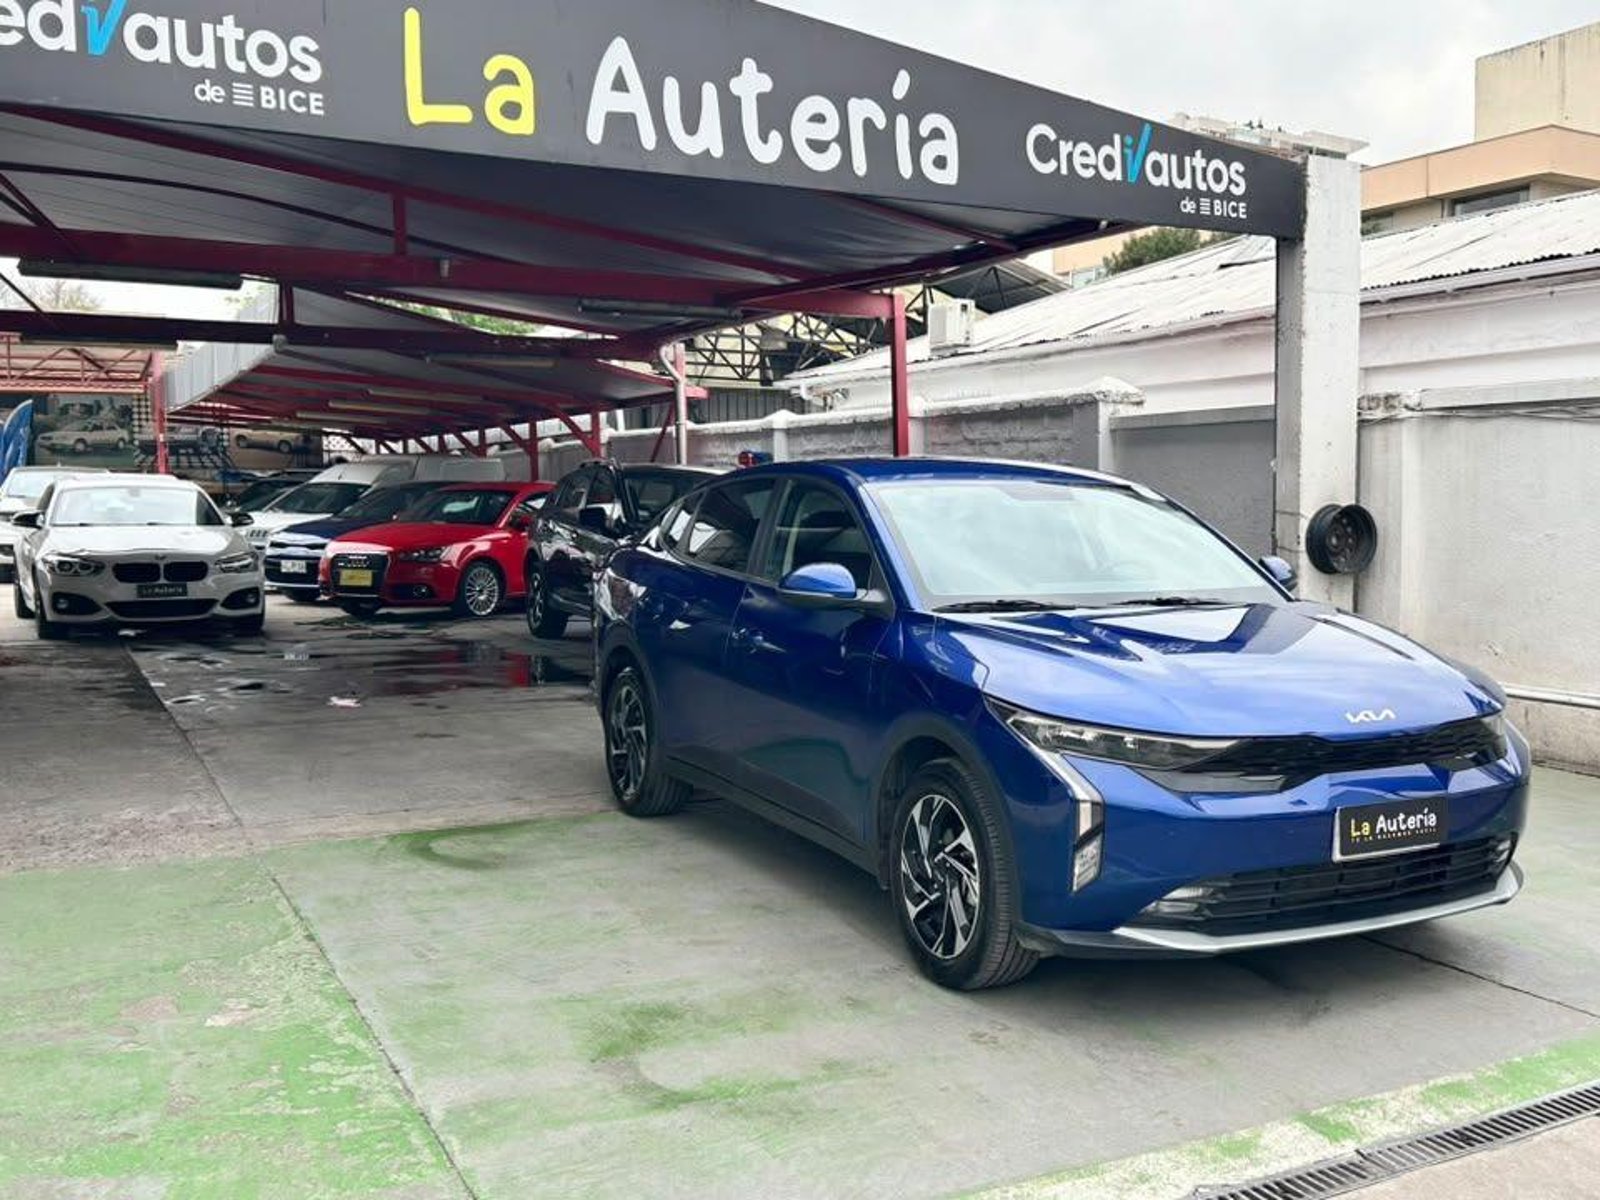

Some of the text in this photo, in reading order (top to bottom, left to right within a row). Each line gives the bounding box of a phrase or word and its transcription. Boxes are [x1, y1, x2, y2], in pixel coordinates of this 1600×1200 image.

[194, 79, 325, 115] de BICE
[404, 7, 960, 186] La Autería
[1179, 196, 1248, 219] de BICE
[1350, 818, 1371, 838] La
[1375, 807, 1437, 834] Autería
